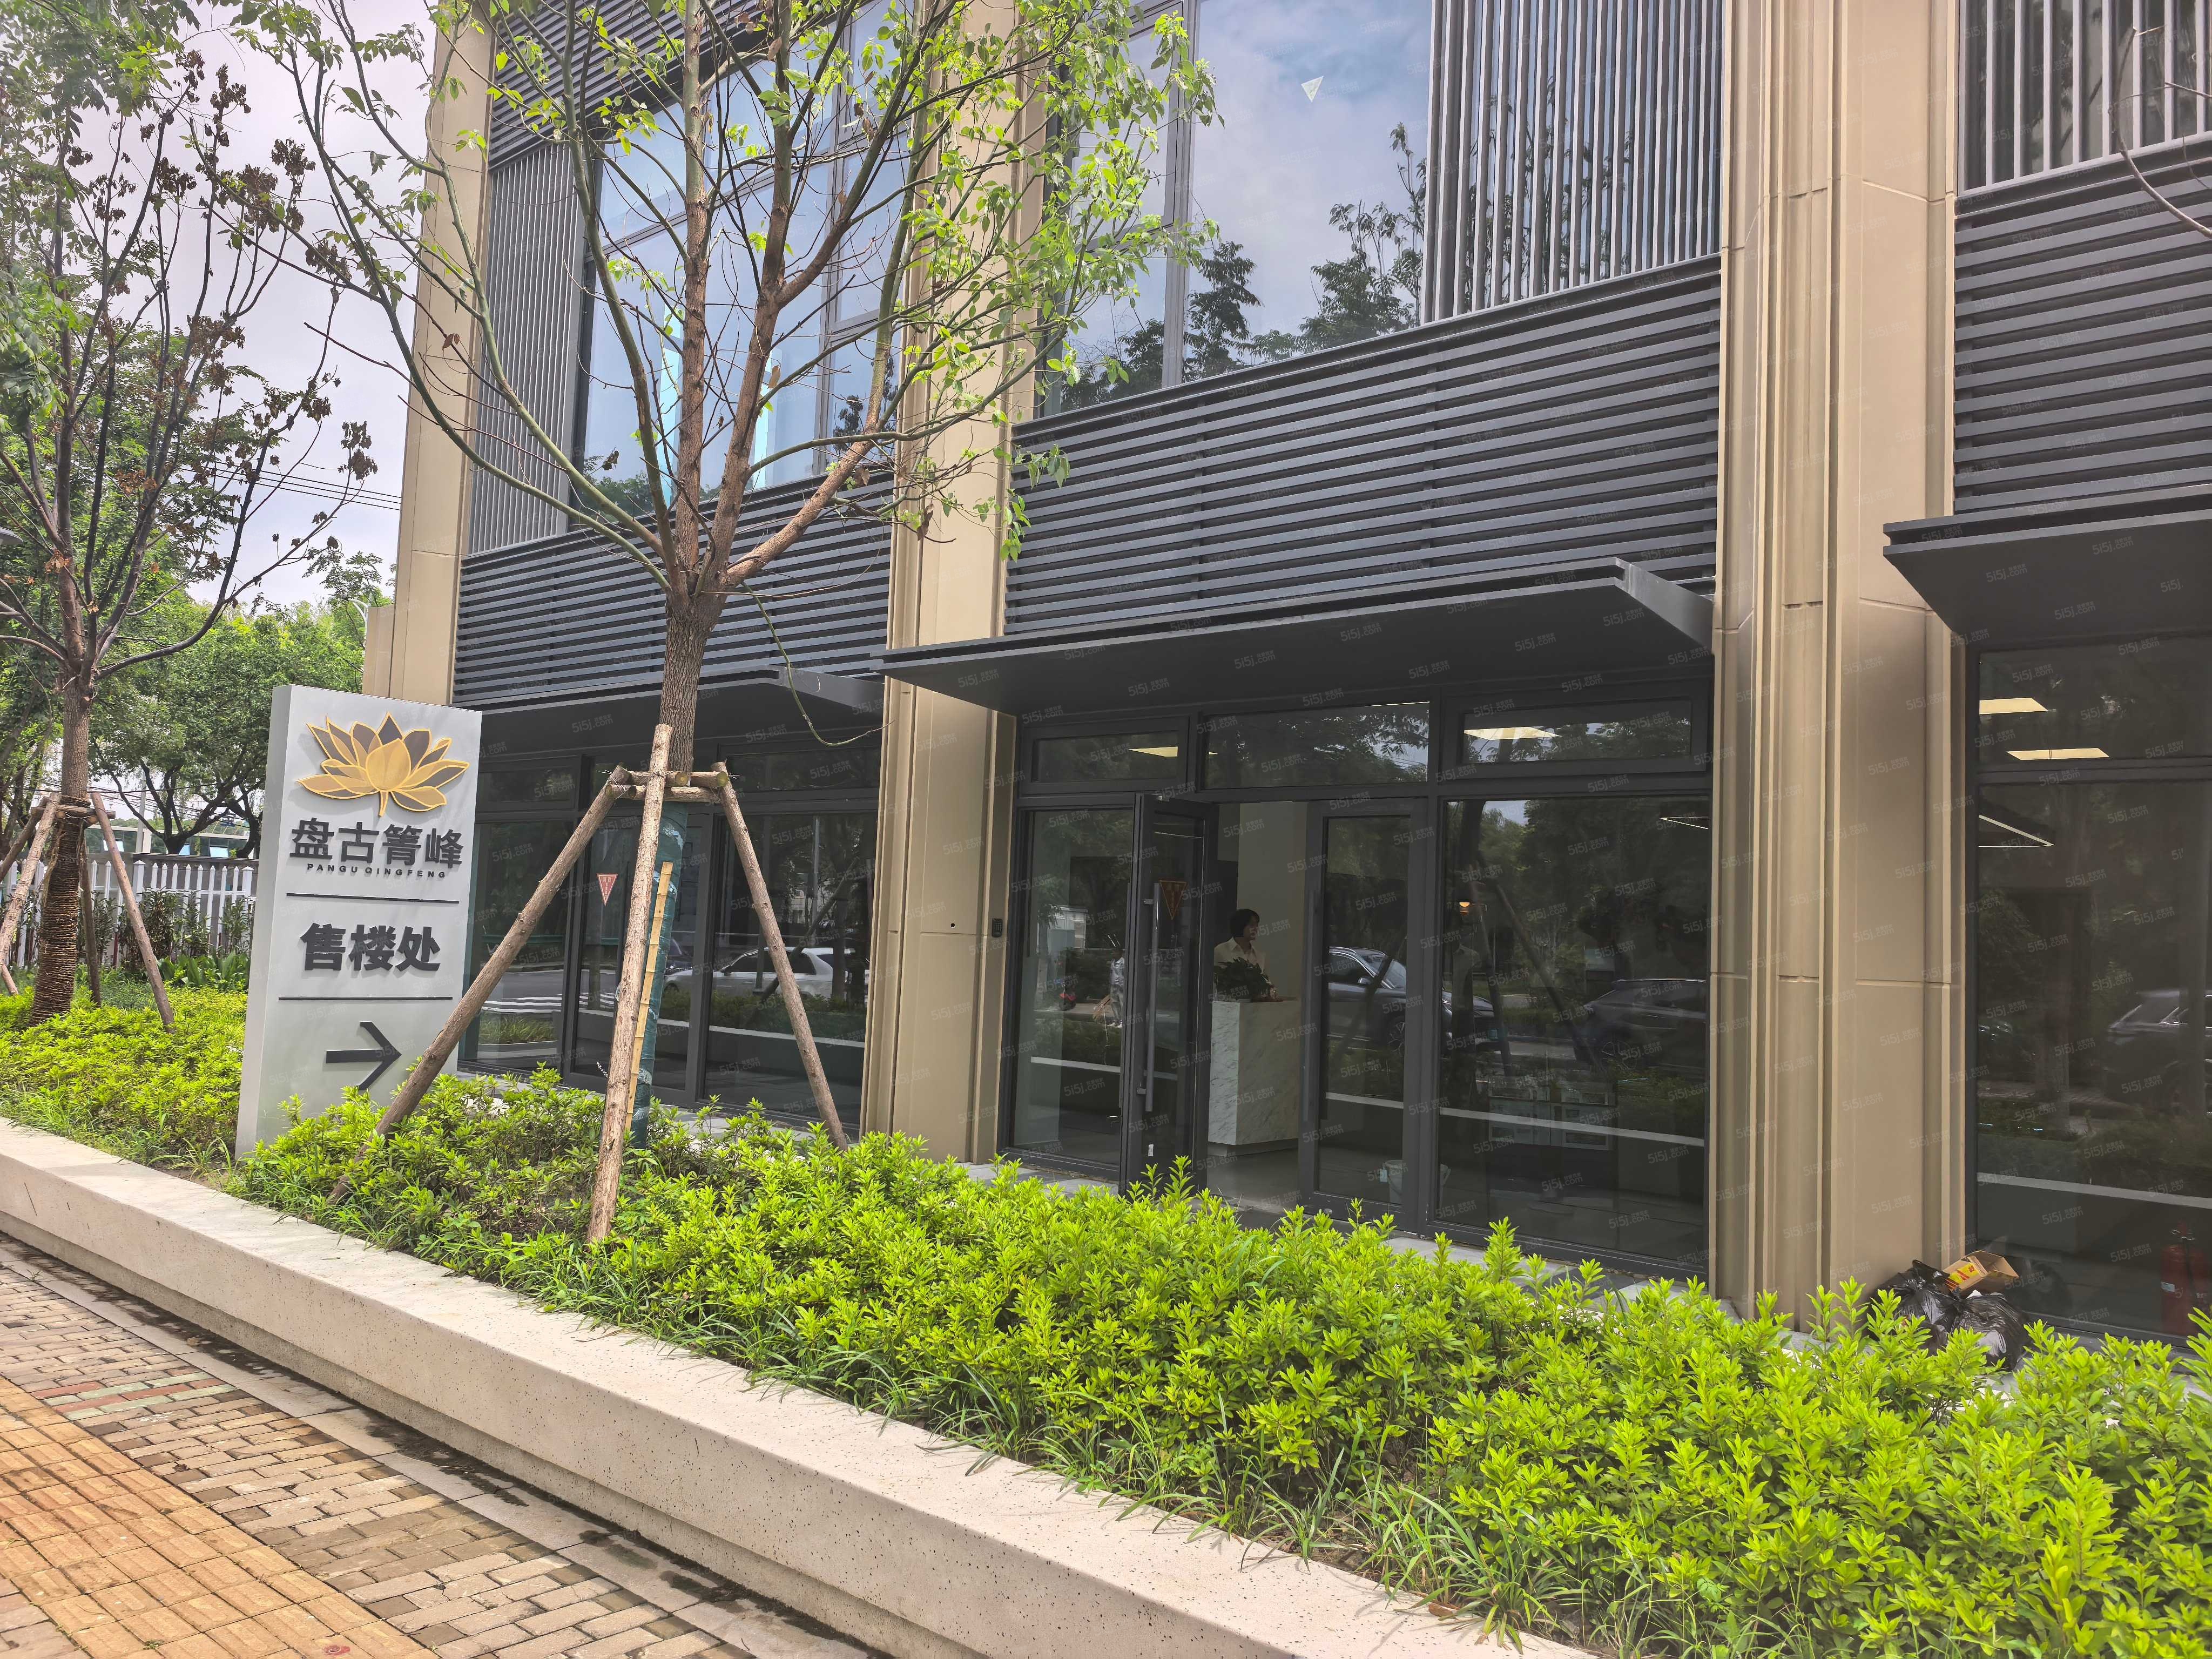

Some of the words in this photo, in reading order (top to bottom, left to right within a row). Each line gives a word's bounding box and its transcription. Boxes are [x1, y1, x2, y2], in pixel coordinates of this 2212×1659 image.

[289, 817, 464, 868] 盘古箐峰
[307, 863, 358, 873] PANGU
[365, 866, 446, 878] QINGFENG
[300, 922, 441, 972] 售楼处
